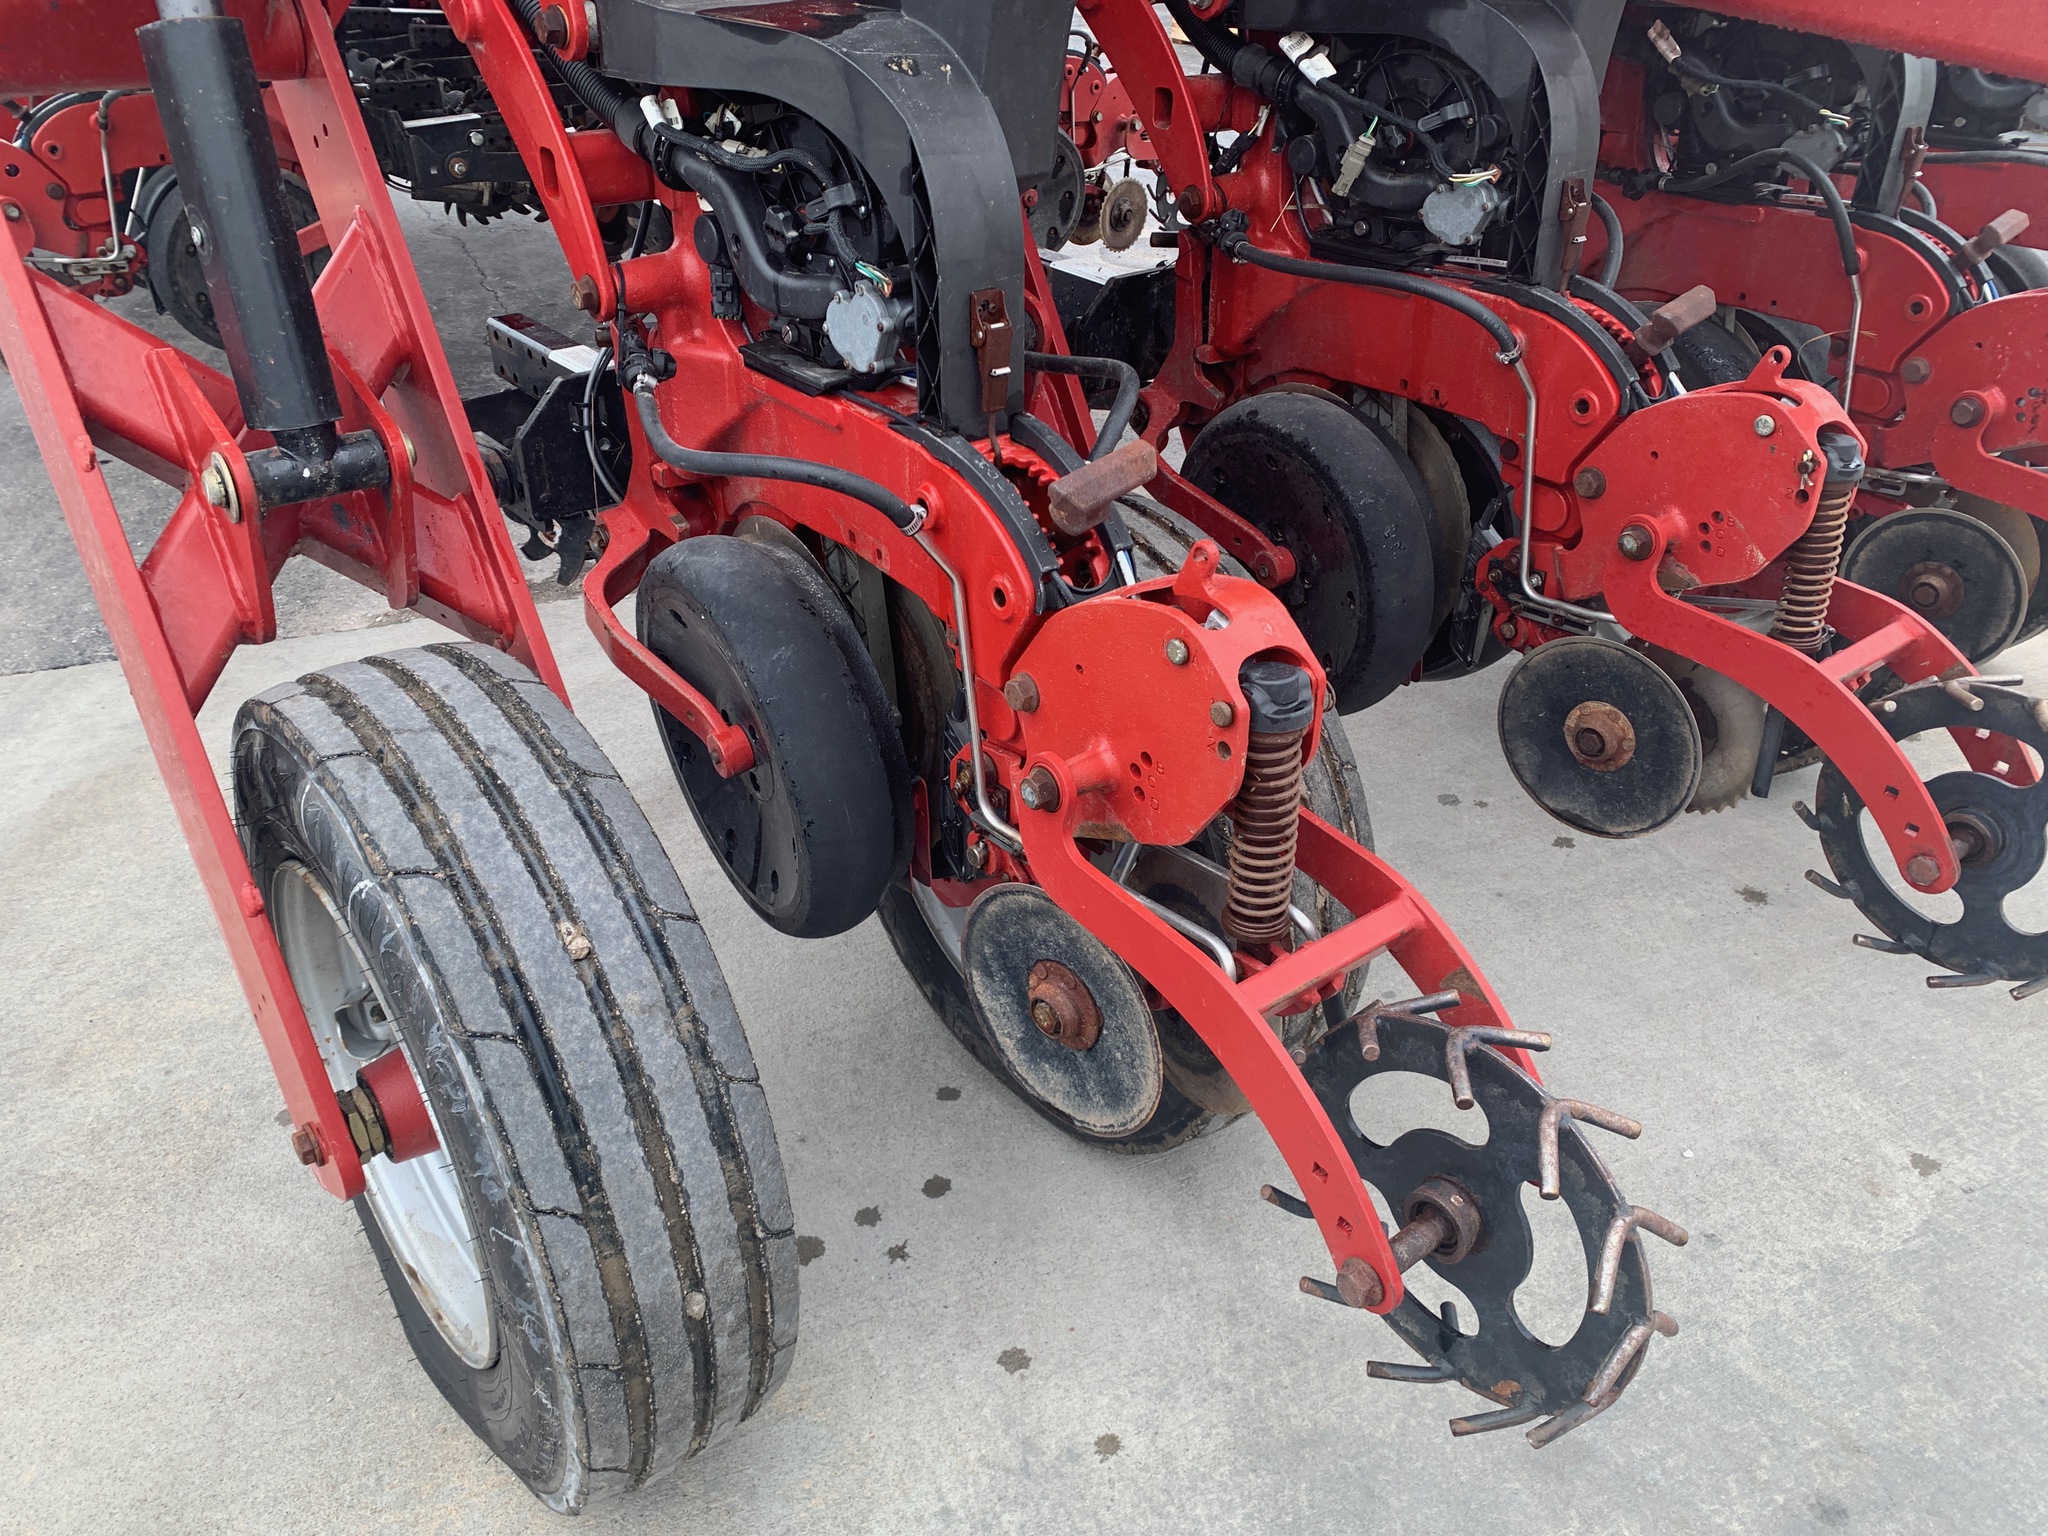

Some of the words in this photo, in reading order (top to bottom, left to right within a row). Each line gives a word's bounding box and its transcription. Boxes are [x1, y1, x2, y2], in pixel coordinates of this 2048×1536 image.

[1785, 487, 1794, 499] 2
[1726, 516, 1735, 527] B
[1716, 529, 1724, 539] C
[1716, 546, 1725, 557] D
[1191, 654, 1199, 670] A
[1207, 736, 1216, 752] 2
[1156, 761, 1165, 776] B
[1147, 775, 1156, 788] C
[1151, 797, 1159, 811] D
